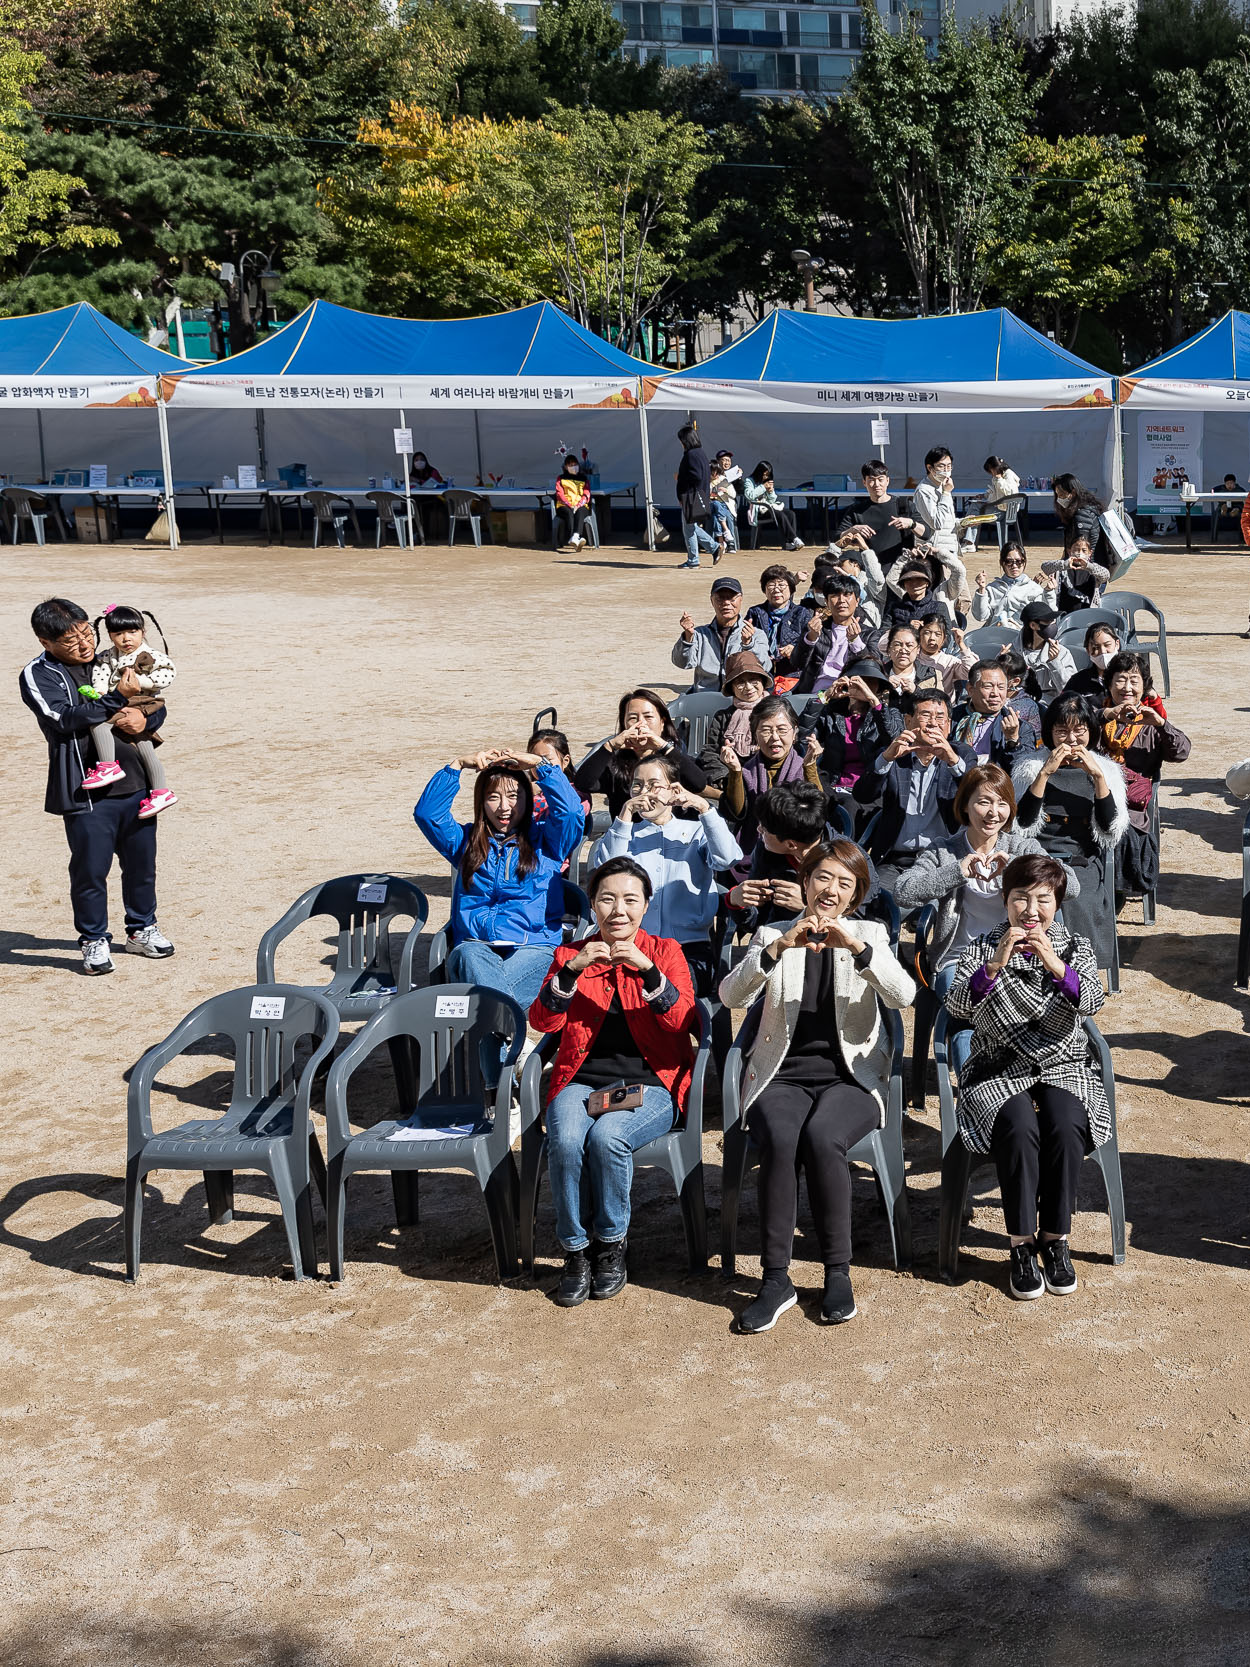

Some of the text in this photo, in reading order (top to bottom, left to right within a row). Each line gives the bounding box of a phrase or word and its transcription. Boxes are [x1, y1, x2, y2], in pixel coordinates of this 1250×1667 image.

[11, 386, 54, 399] 압화액자
[57, 386, 90, 399] 만들기
[244, 386, 385, 400] 베트남 전통모자(논라) 만들기
[430, 388, 574, 400] 세계 여러나라 바람개비 만들기
[817, 390, 939, 402] 미니 세계 여행가방 만들기
